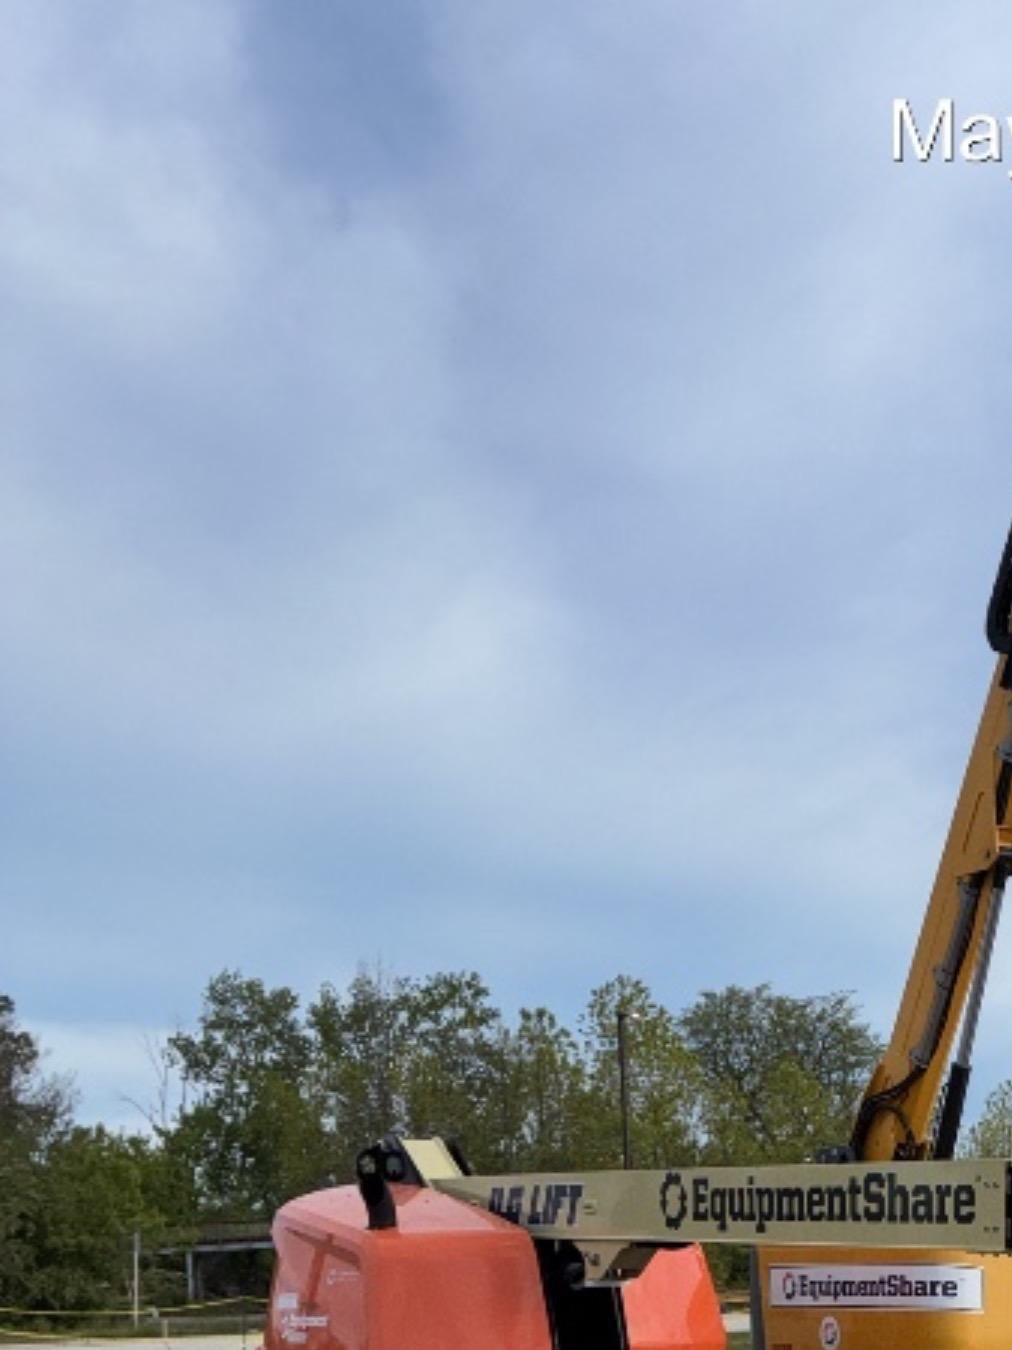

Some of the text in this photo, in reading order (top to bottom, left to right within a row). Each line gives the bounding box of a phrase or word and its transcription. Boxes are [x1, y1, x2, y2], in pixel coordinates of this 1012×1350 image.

[526, 1183, 584, 1226] LIFT
[691, 1172, 976, 1233] EquipmentShare
[798, 1273, 960, 1301] EquipmentShare
